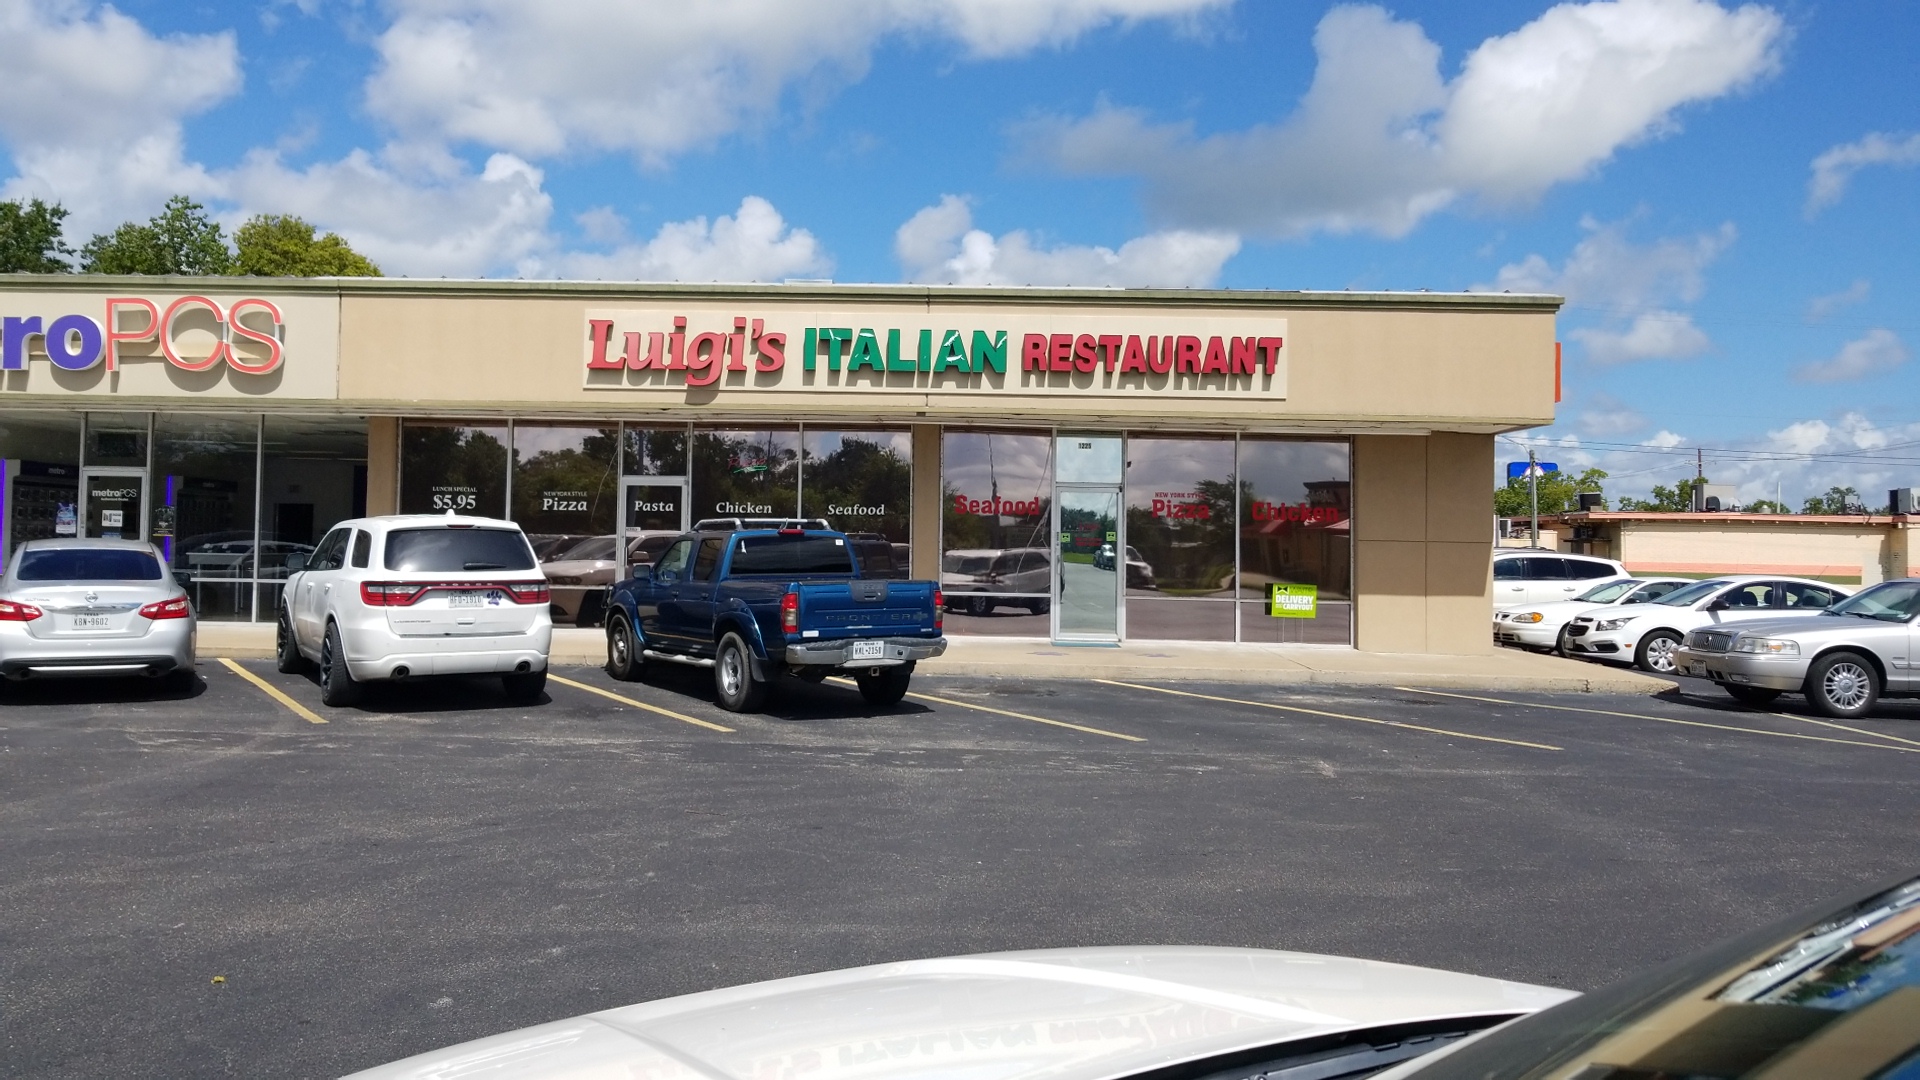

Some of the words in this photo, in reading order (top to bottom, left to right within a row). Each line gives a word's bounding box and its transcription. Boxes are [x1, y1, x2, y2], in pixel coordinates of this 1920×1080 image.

[0, 296, 284, 374] roPCS
[587, 316, 786, 386] Luigi's
[804, 328, 1007, 373] ITALIAN
[1023, 333, 1283, 375] RESTAURANT
[92, 489, 137, 498] metroPCS
[433, 494, 476, 509] $5.95
[542, 497, 588, 511] Pizza
[634, 500, 674, 512] Pasta
[716, 502, 772, 514] Chicken
[954, 494, 1040, 515] Seafood
[827, 503, 886, 516] Seafood
[1151, 499, 1210, 519] Pizza
[1252, 501, 1340, 522] Chicken
[1276, 594, 1314, 604] DELIVERY
